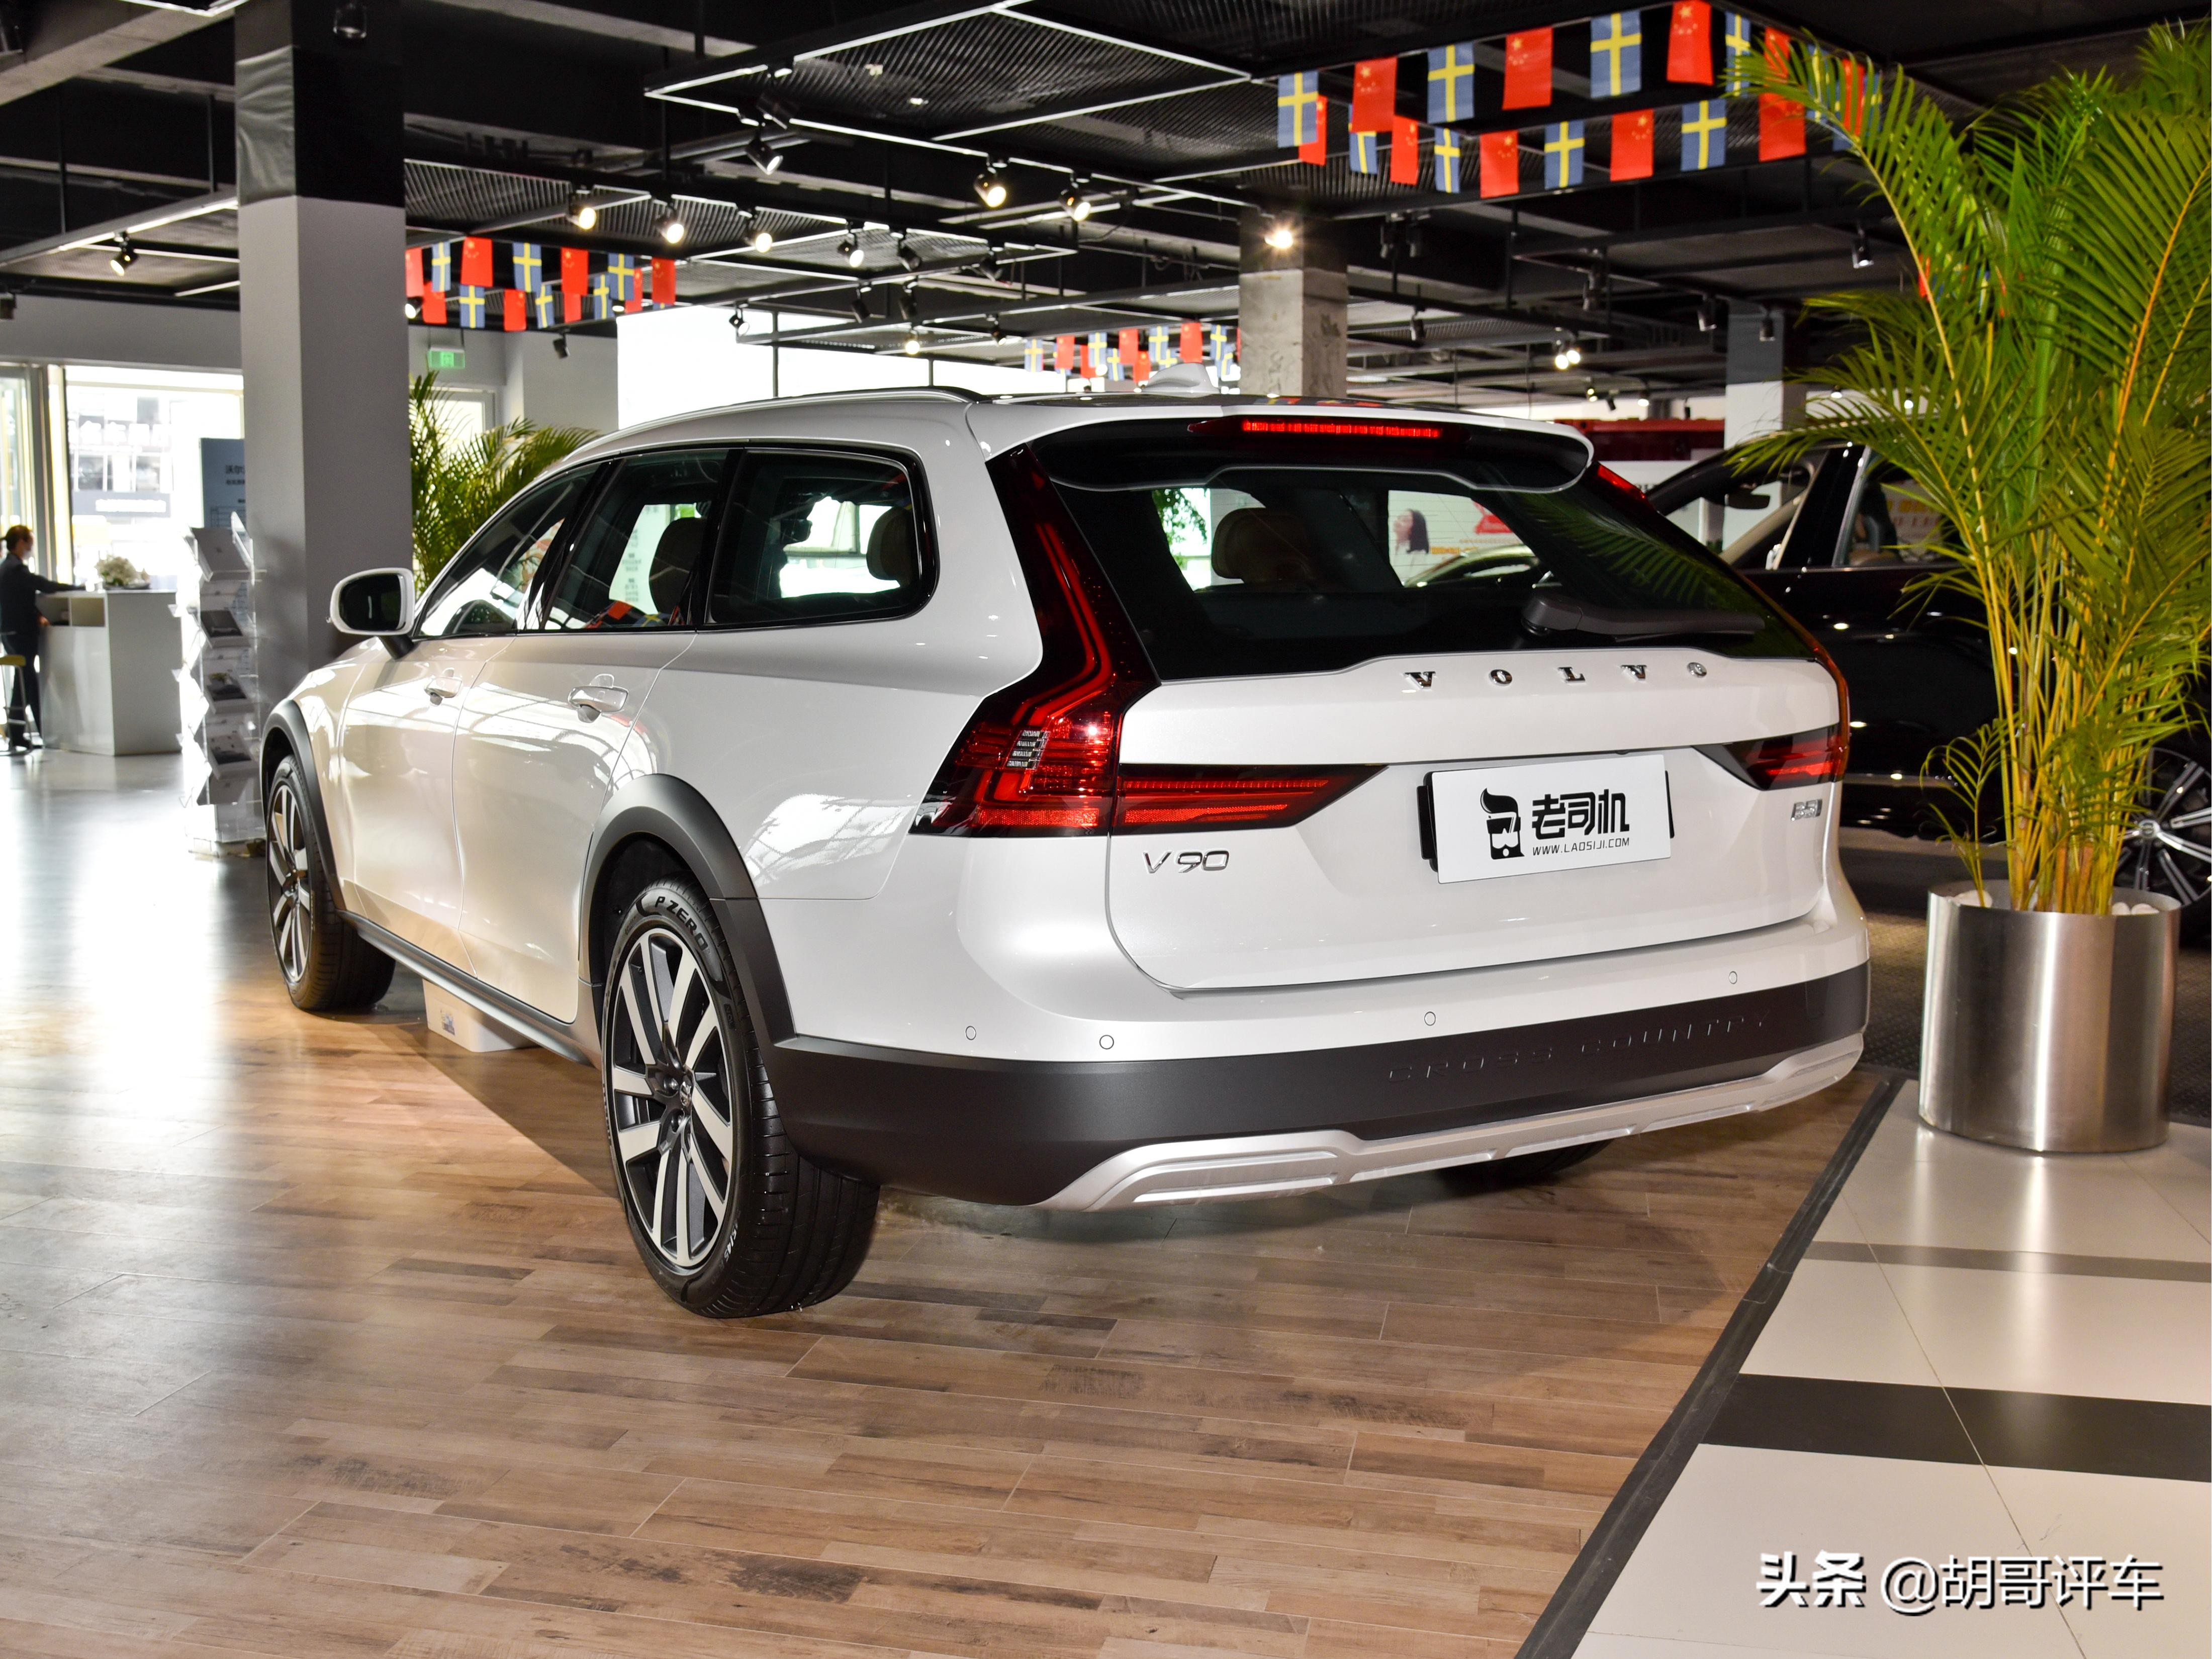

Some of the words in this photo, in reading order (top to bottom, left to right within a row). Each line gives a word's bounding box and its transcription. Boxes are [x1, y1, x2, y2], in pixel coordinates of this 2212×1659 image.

[1404, 661, 1708, 689] VOLVO
[1532, 789, 1629, 840] 老司机
[1143, 850, 1229, 873] V90
[1532, 837, 1629, 856] WWW.LAOSIJI.COM
[666, 899, 708, 951] ZERO
[1389, 1047, 1553, 1083] CROSS
[1581, 1008, 1771, 1056] COUNTRY
